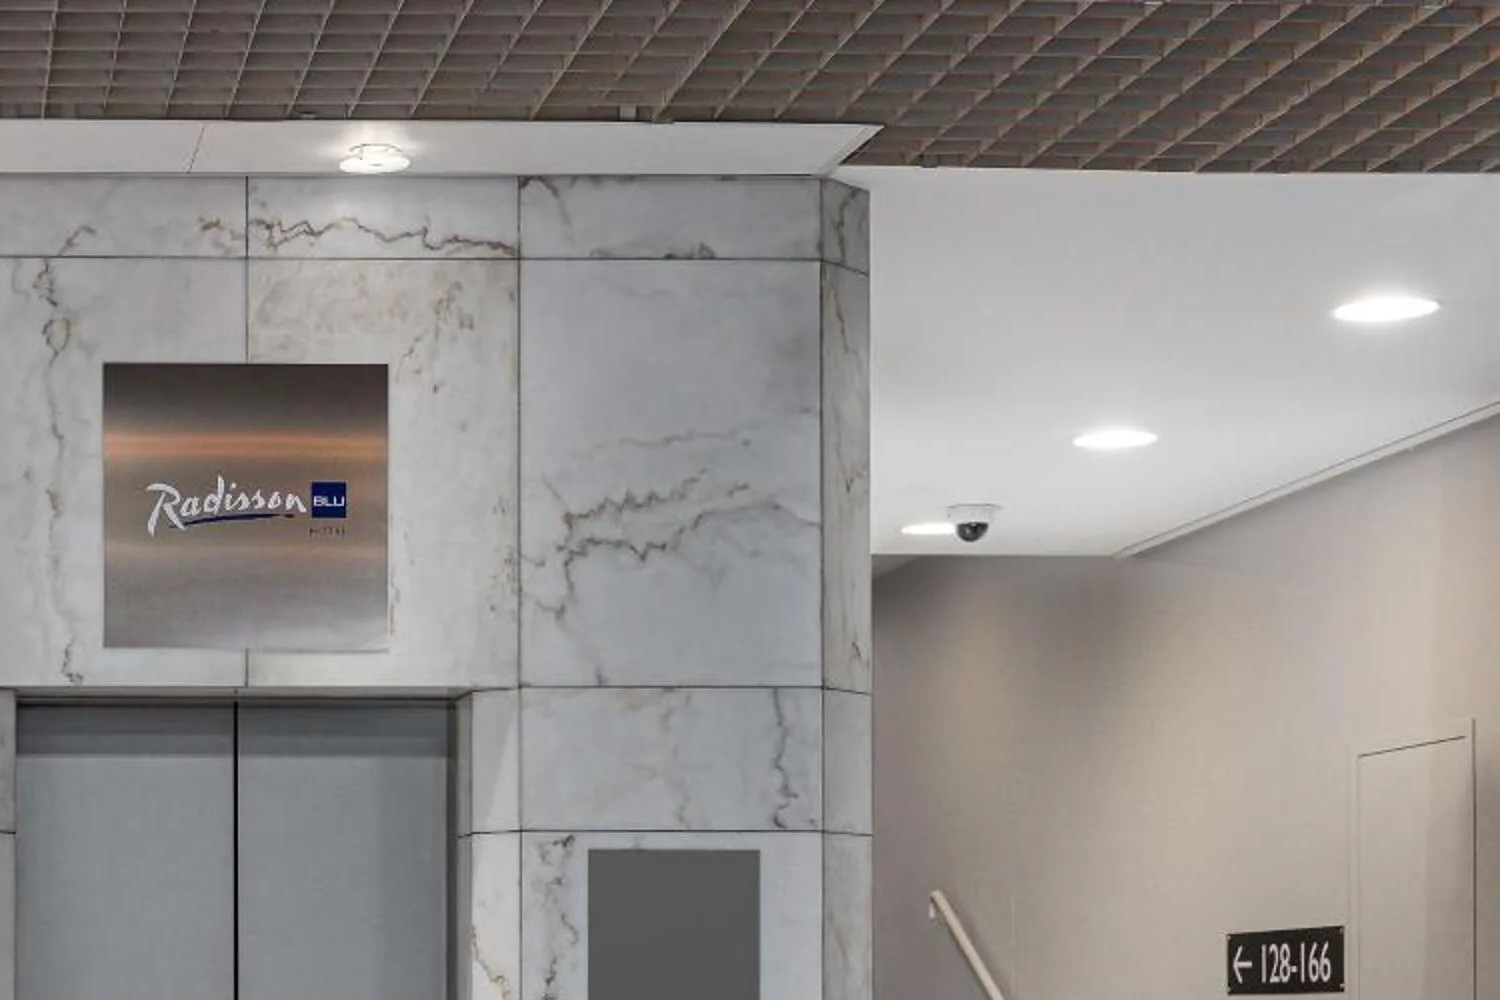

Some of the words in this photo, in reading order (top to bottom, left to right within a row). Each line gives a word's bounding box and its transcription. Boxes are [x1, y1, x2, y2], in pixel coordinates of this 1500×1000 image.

[146, 475, 307, 537] Radisson
[313, 495, 345, 507] BLU
[1261, 941, 1331, 983] 128-166
